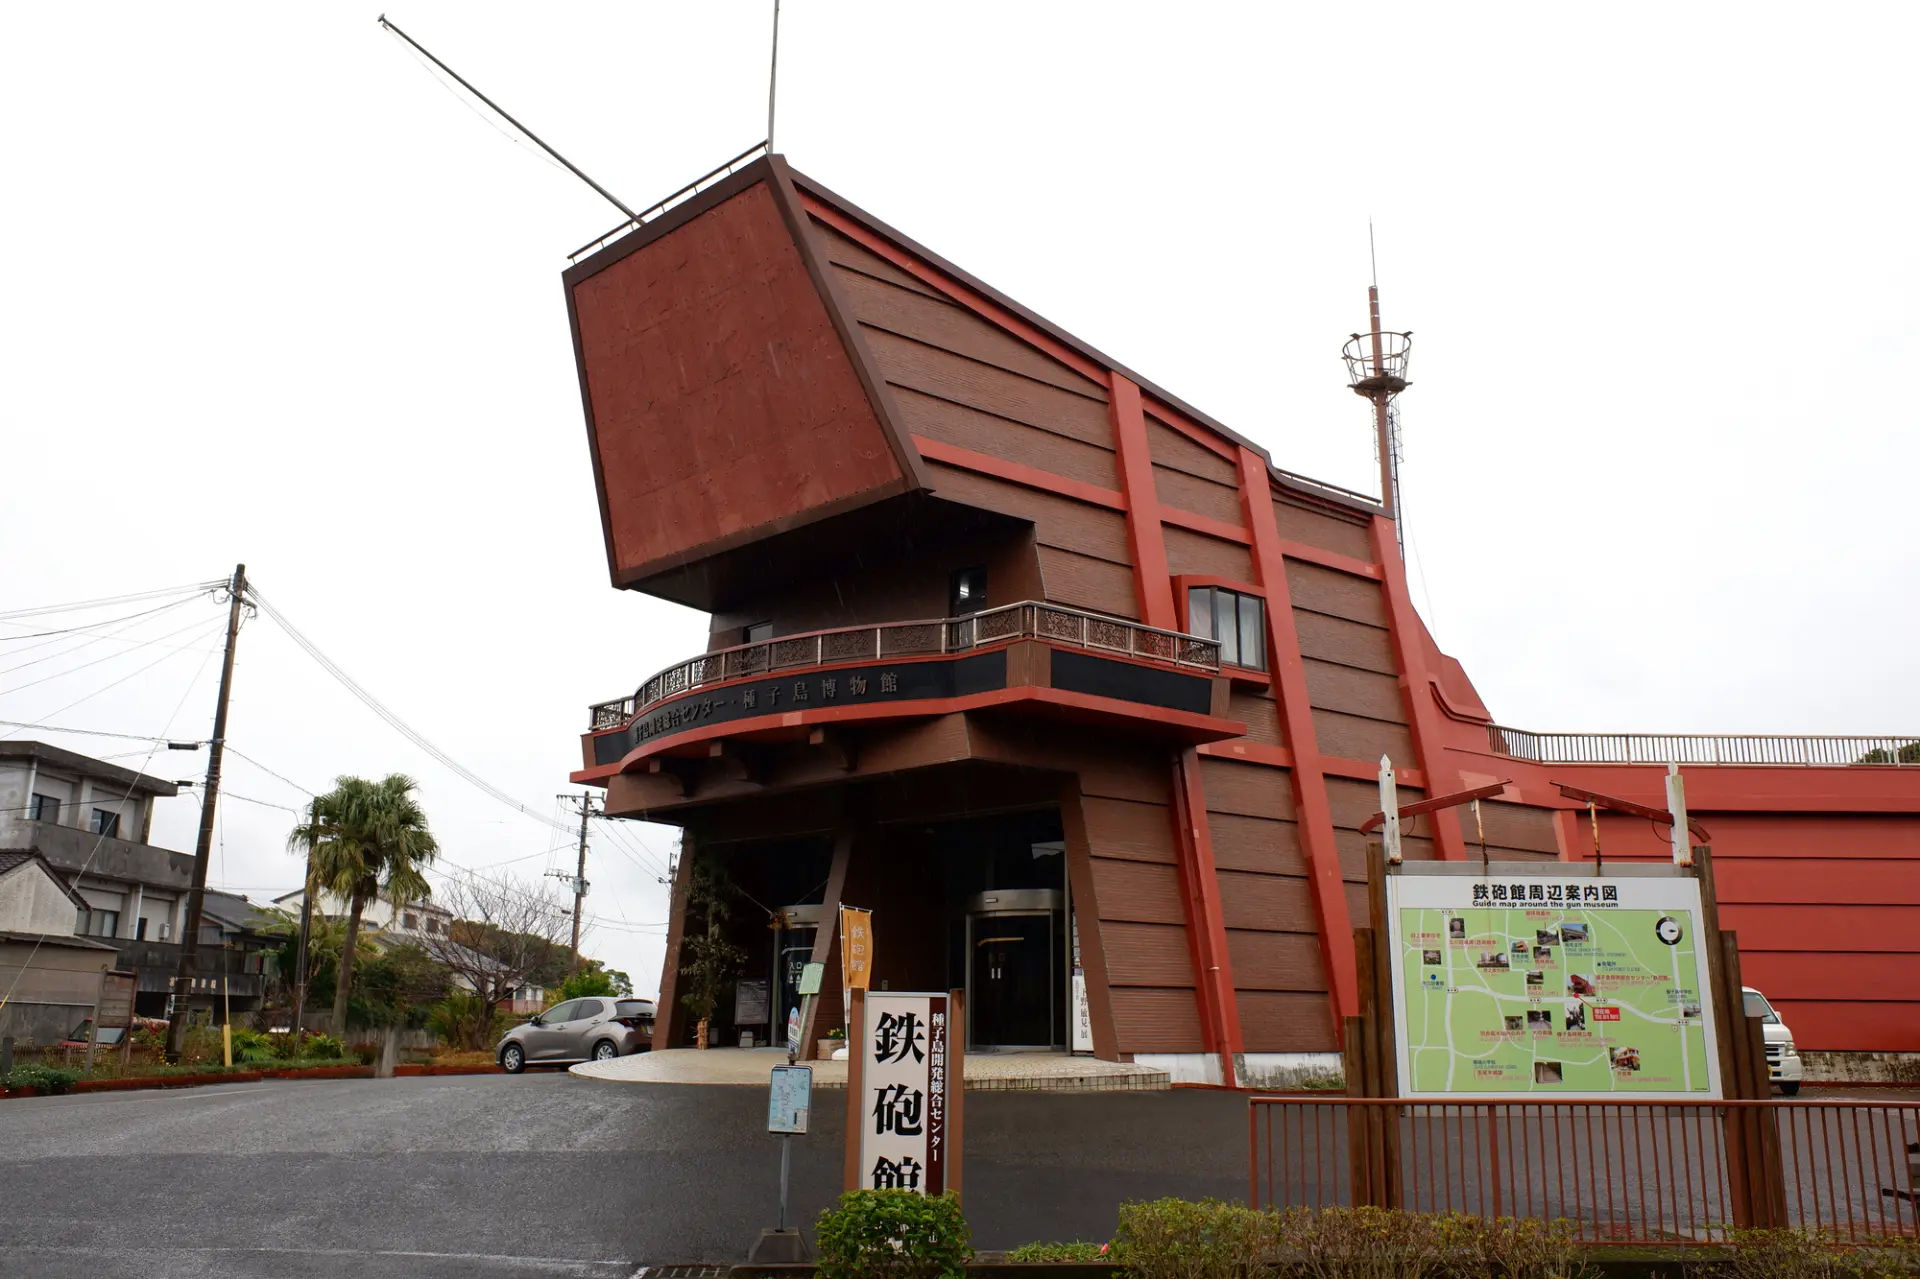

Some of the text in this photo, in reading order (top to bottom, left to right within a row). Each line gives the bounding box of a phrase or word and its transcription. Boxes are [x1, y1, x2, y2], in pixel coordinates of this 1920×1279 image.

[1472, 884, 1619, 901] 鉄砲館周辺案内図
[1472, 900, 1497, 908] Guide
[1519, 900, 1548, 908] around
[1550, 900, 1564, 908] the
[872, 1012, 925, 1192] 鉄砲館
[930, 1013, 945, 1163] 種子島開発総合センター
